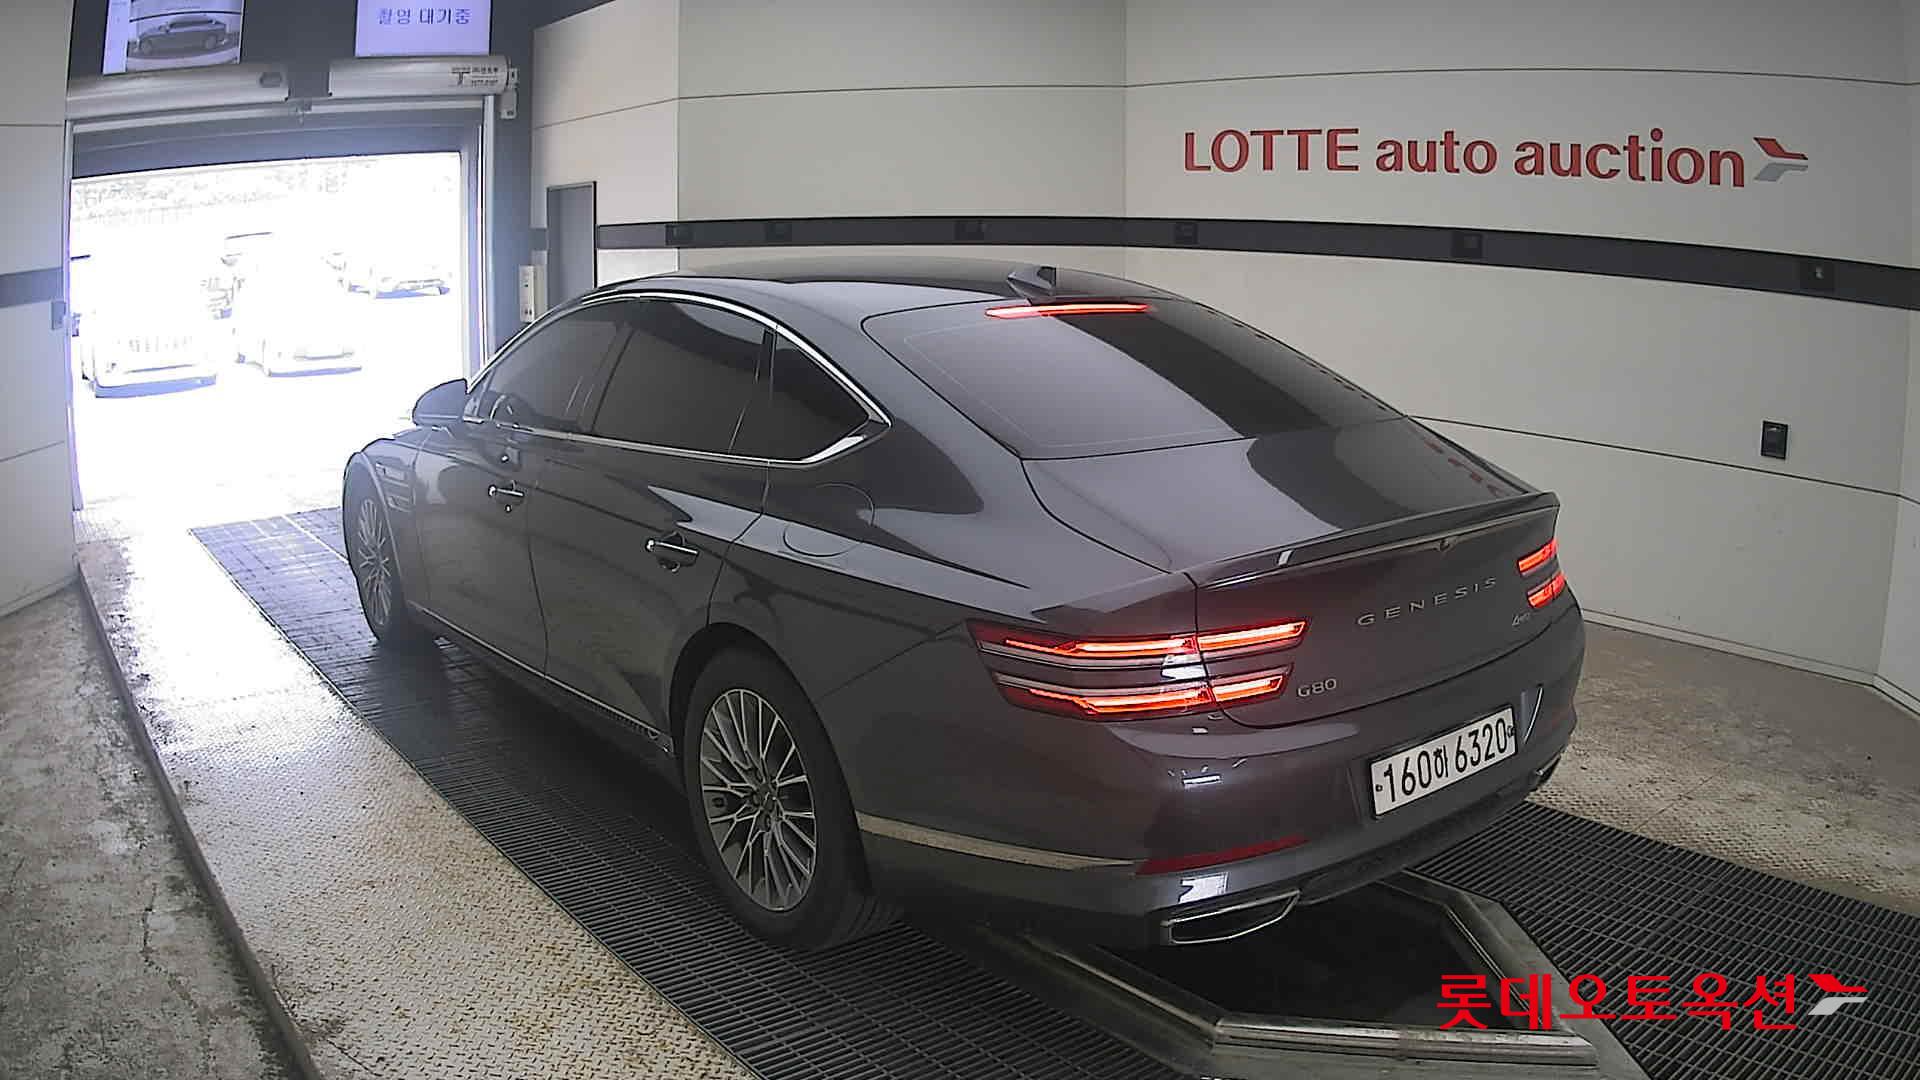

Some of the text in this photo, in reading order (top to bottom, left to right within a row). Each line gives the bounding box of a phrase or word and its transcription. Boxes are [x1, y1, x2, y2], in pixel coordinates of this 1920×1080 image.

[419, 8, 472, 25] 대기중
[1185, 128, 1745, 187] LOTTE auto auction
[1357, 577, 1497, 627] GENESIS
[1297, 678, 1337, 697] G80
